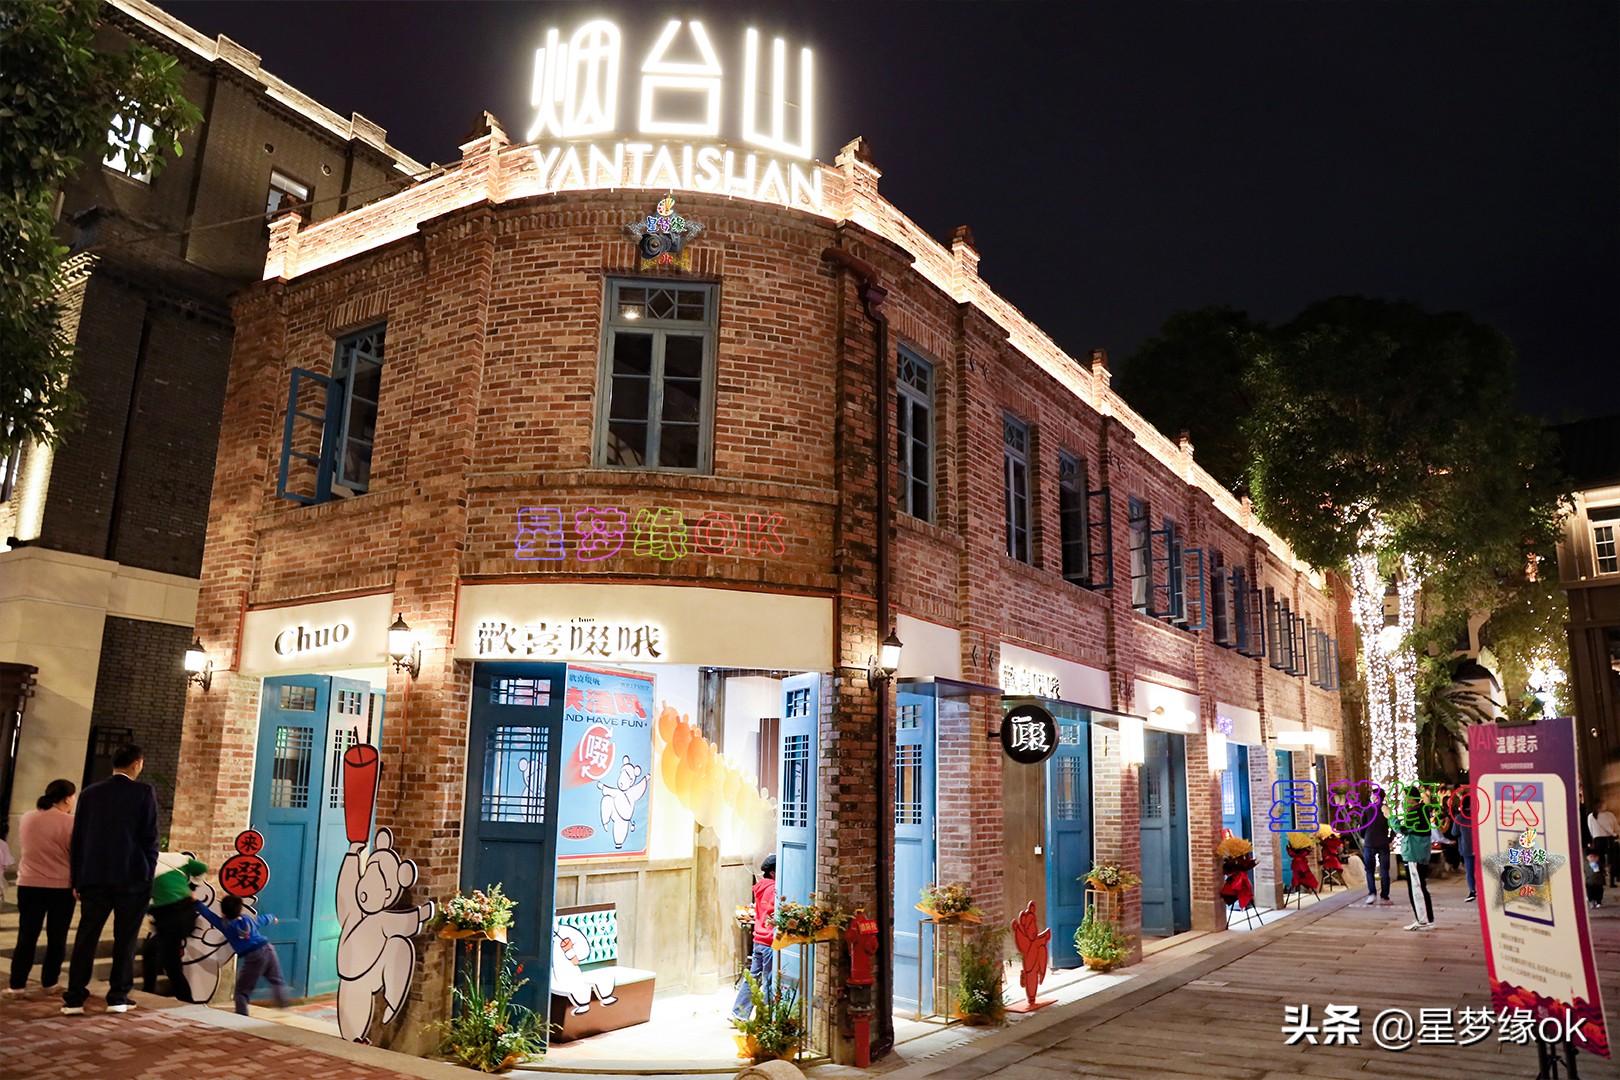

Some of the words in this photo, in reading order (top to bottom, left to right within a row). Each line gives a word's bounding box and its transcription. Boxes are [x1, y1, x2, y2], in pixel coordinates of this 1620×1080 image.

[526, 20, 813, 160] 烟台山
[532, 142, 823, 211] YANTAISHAN
[274, 623, 350, 656] Chuo
[565, 714, 584, 723] ND
[586, 715, 618, 726] HAVE
[1496, 735, 1538, 754] 温馨提示
